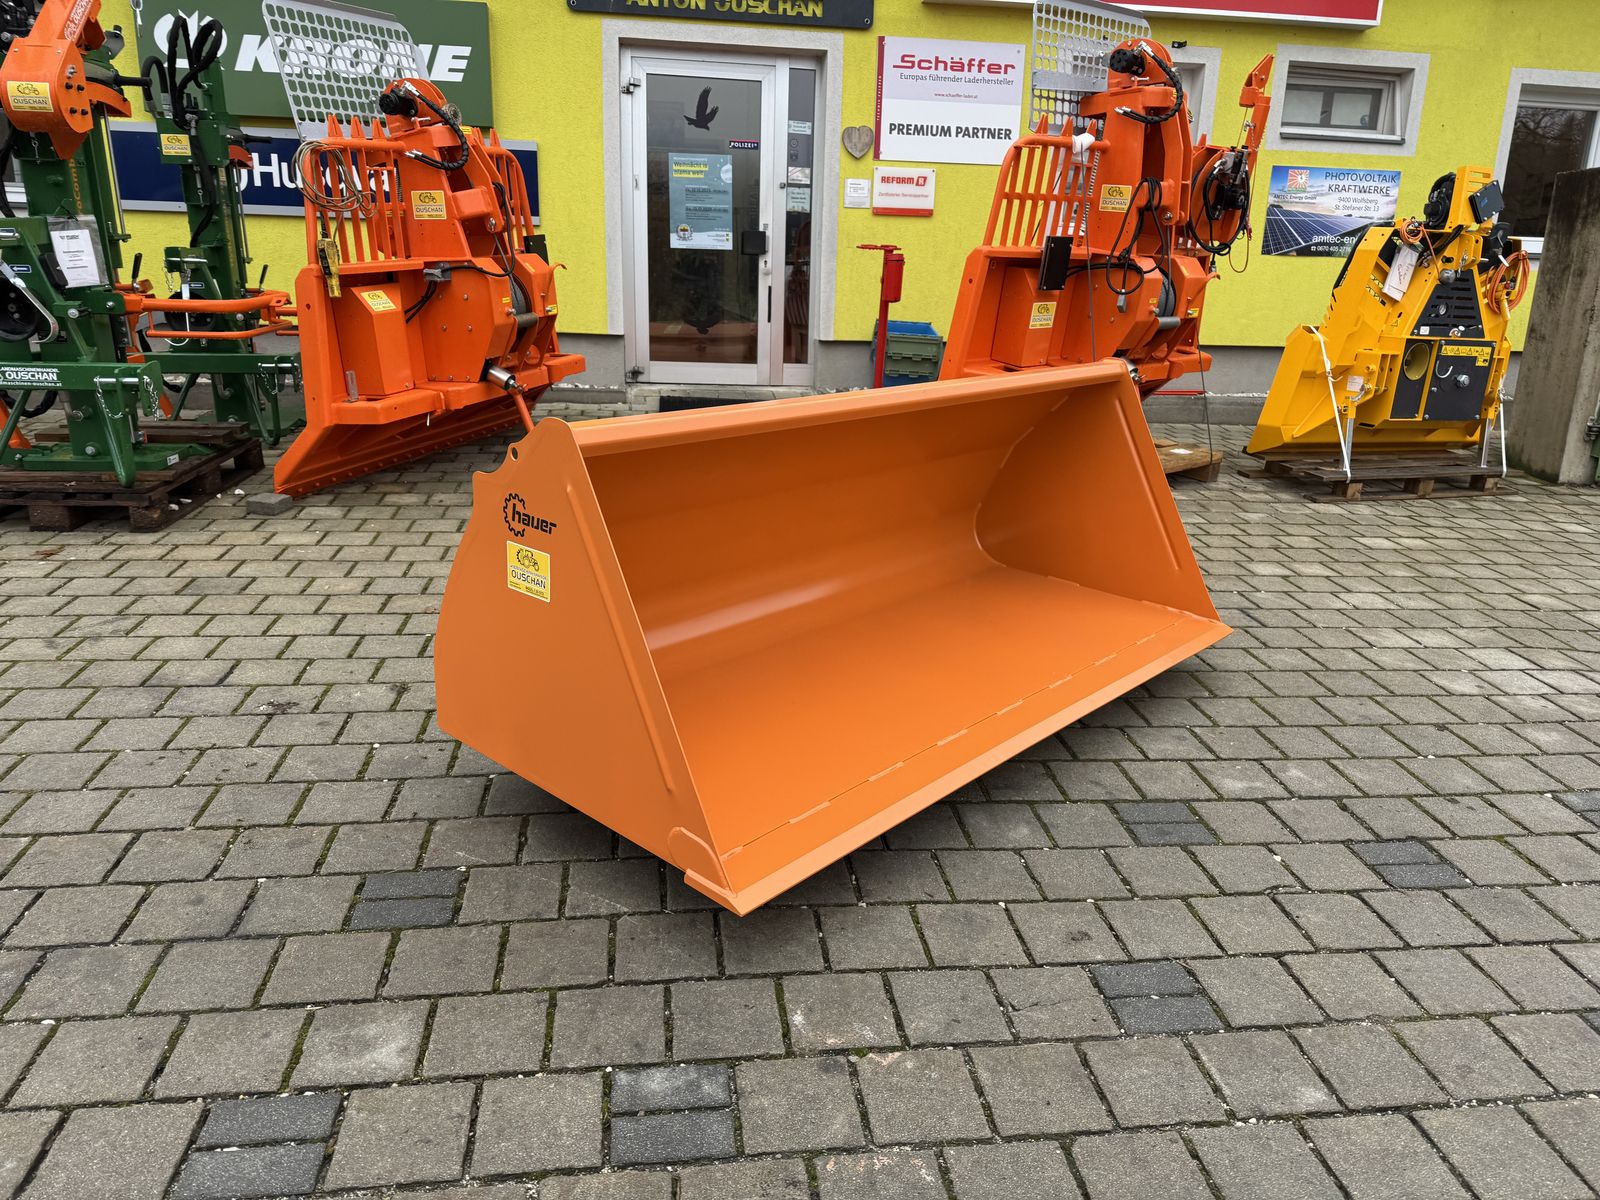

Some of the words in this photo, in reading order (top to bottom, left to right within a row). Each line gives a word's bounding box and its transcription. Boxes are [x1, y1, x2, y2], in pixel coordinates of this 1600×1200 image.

[234, 34, 472, 83] KRONE
[893, 54, 1015, 75] Schäffer
[900, 73, 927, 81] Europas
[929, 74, 963, 83] führender
[964, 76, 1014, 85] Laderhersteller
[889, 123, 952, 137] PREMIUM
[956, 126, 1012, 140] PARTNER
[881, 176, 914, 185] REFORM
[1325, 171, 1397, 184] PHOTOVOLTAIK
[1328, 184, 1391, 195] KRAFTWERKE
[1352, 197, 1378, 205] Wolfsberg
[5, 371, 58, 380] OUSCHAN
[511, 503, 557, 535] hauer
[511, 569, 546, 589] OUSCHAN
